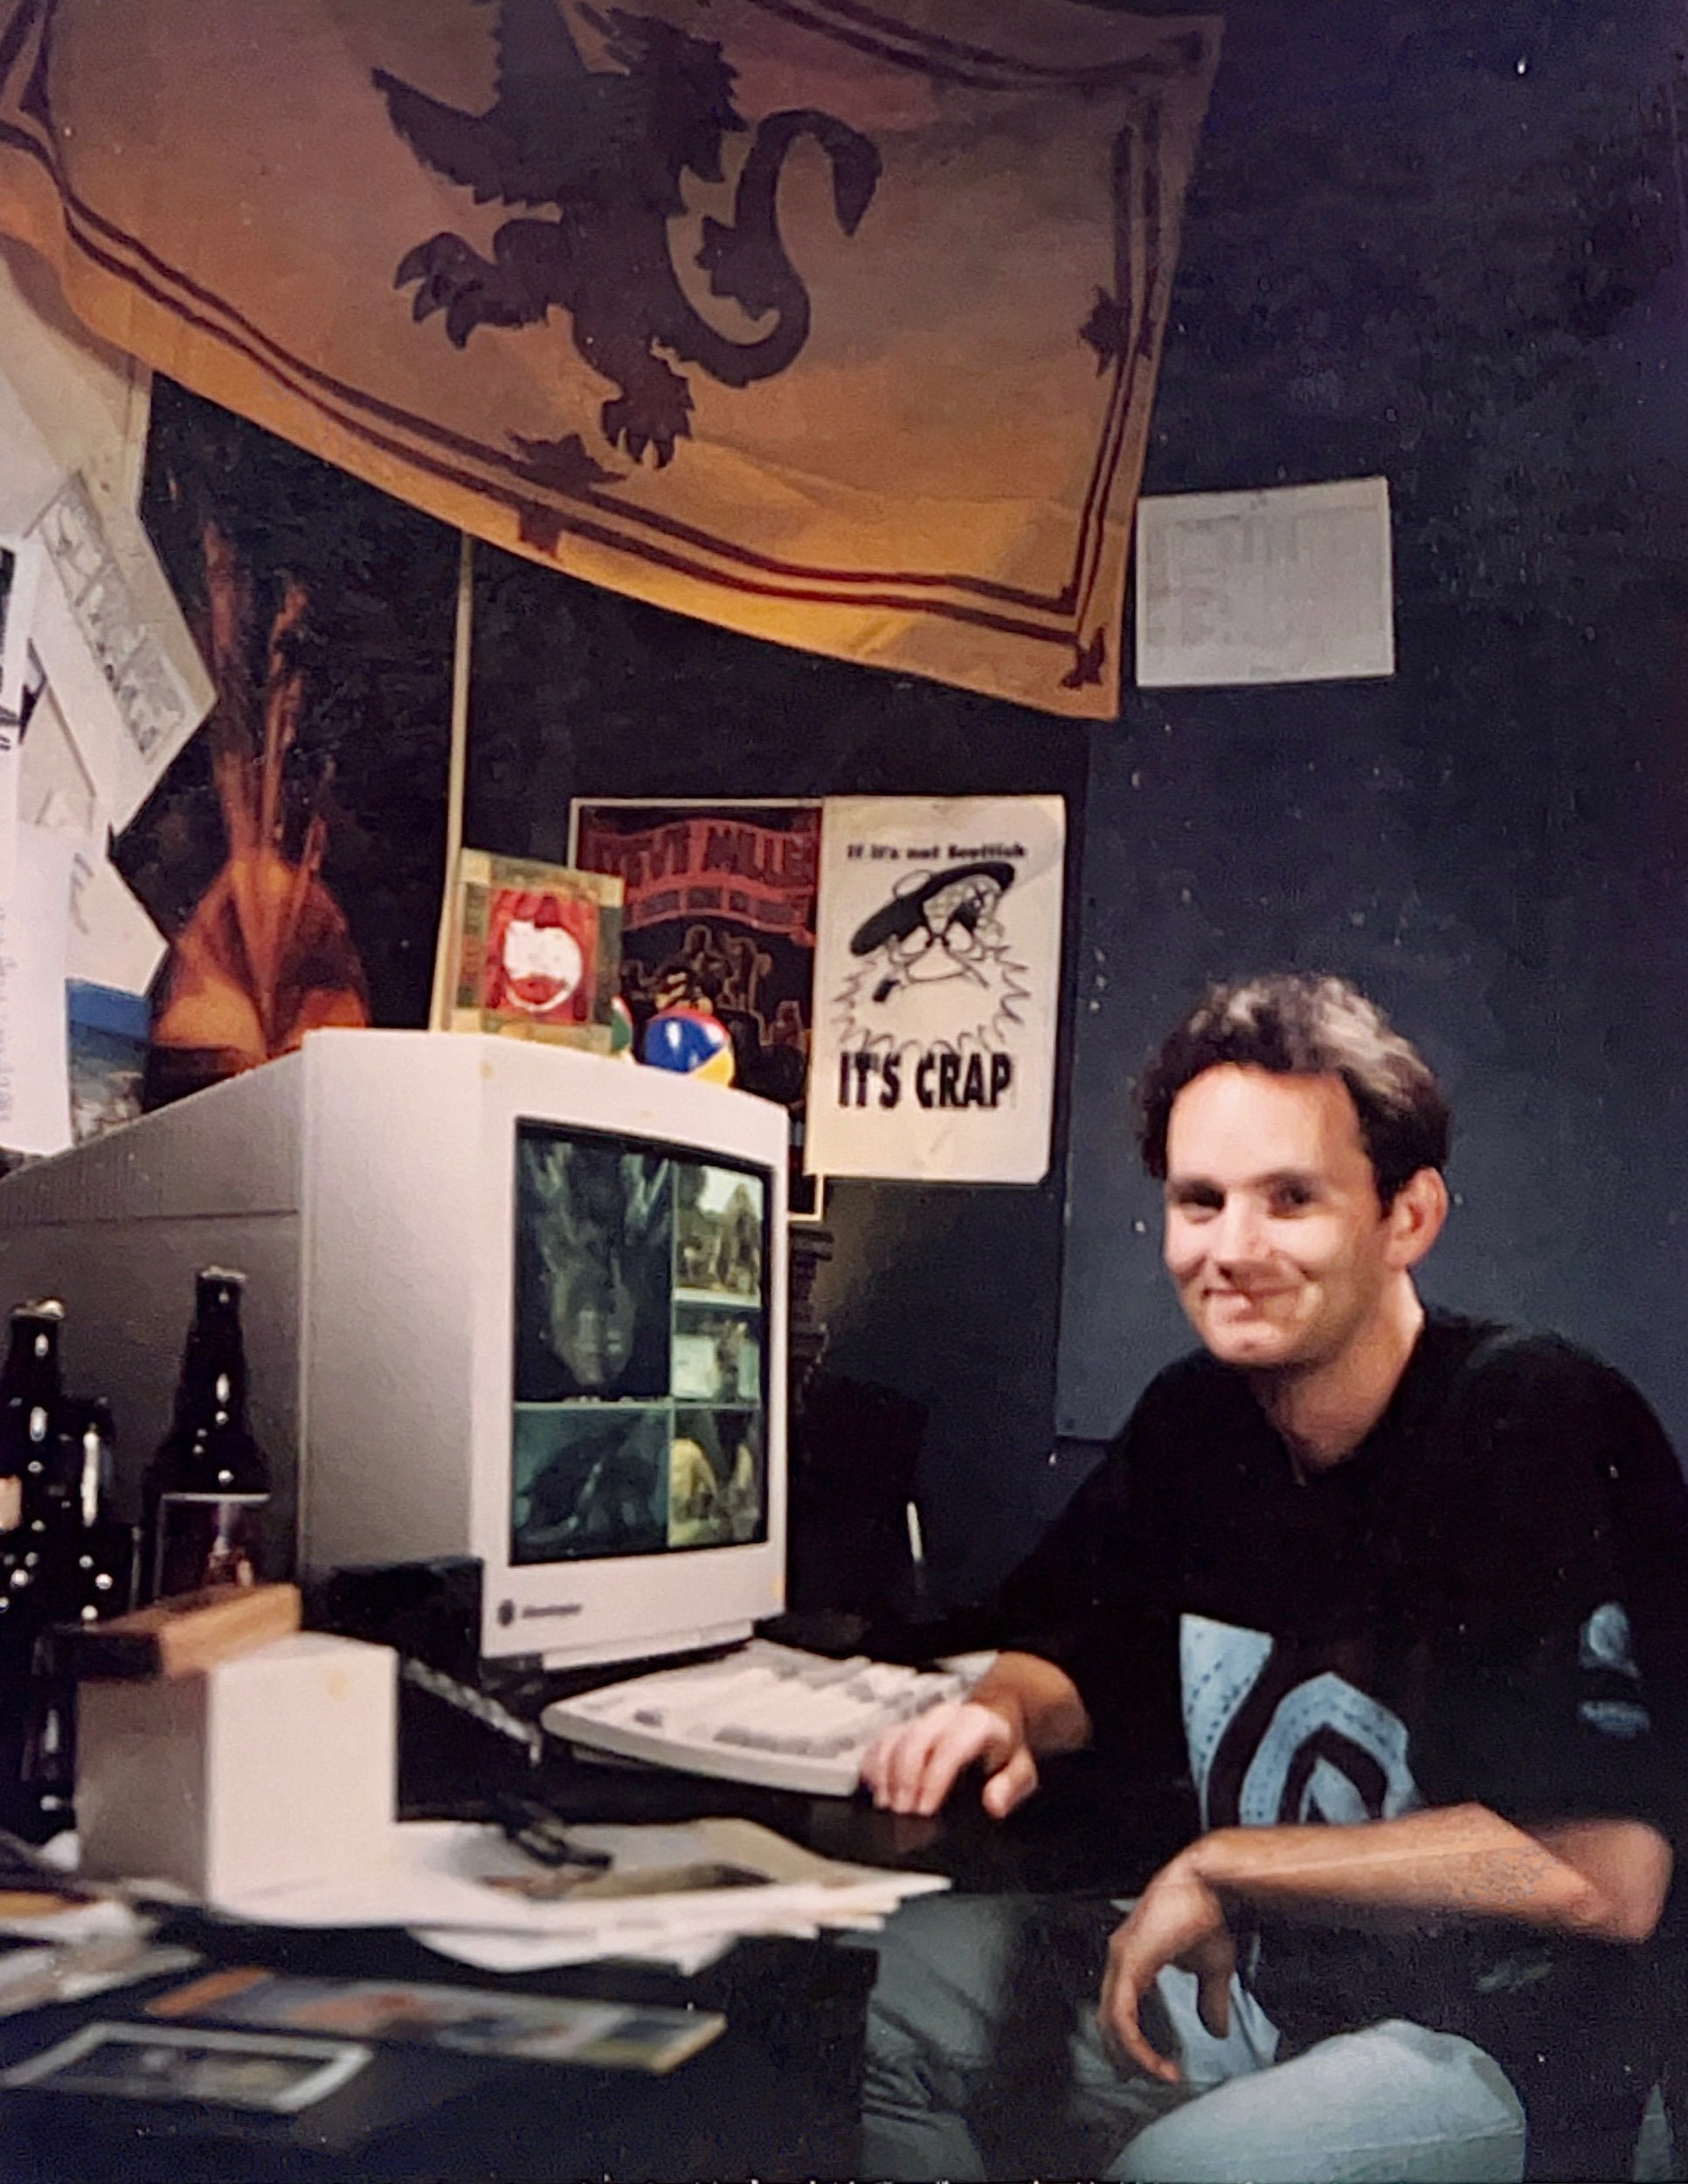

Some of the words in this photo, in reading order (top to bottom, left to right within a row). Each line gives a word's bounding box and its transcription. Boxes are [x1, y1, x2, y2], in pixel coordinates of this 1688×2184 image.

[906, 844, 941, 860] not
[948, 840, 1026, 860] Scottish
[839, 1051, 902, 1109] IT'S
[916, 1051, 1012, 1109] CRAP
